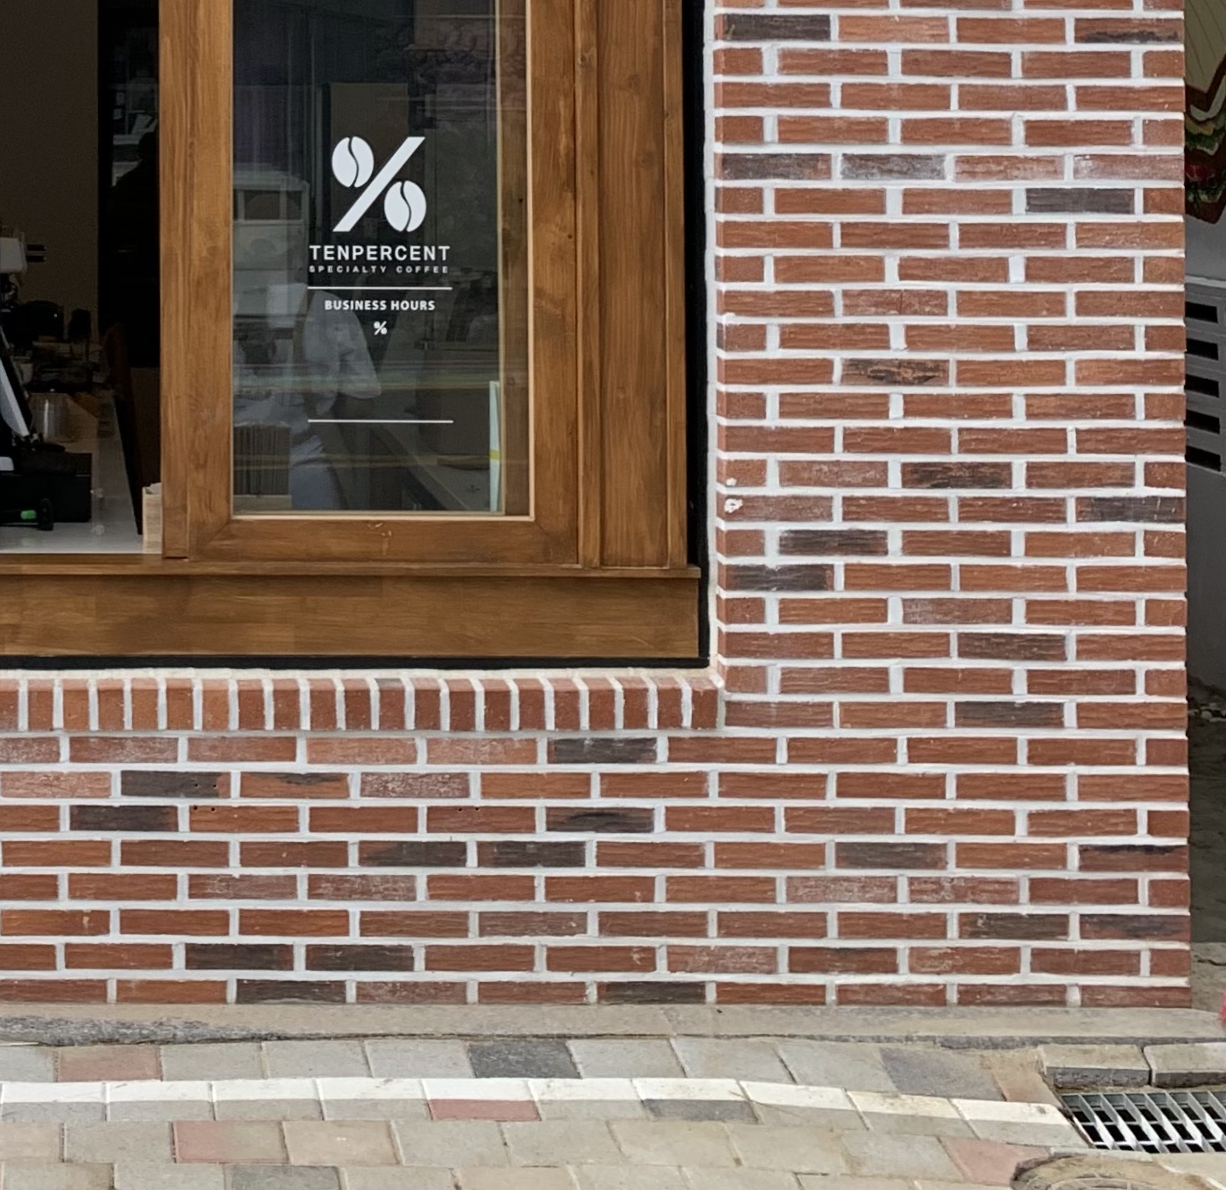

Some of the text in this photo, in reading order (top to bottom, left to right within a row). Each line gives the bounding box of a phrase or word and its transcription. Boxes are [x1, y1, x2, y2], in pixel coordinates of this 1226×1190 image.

[309, 245, 450, 261] TENPERCENT
[309, 265, 449, 274] SPECIALTY COFFEE
[324, 300, 435, 311] BUSINESS HOURS
